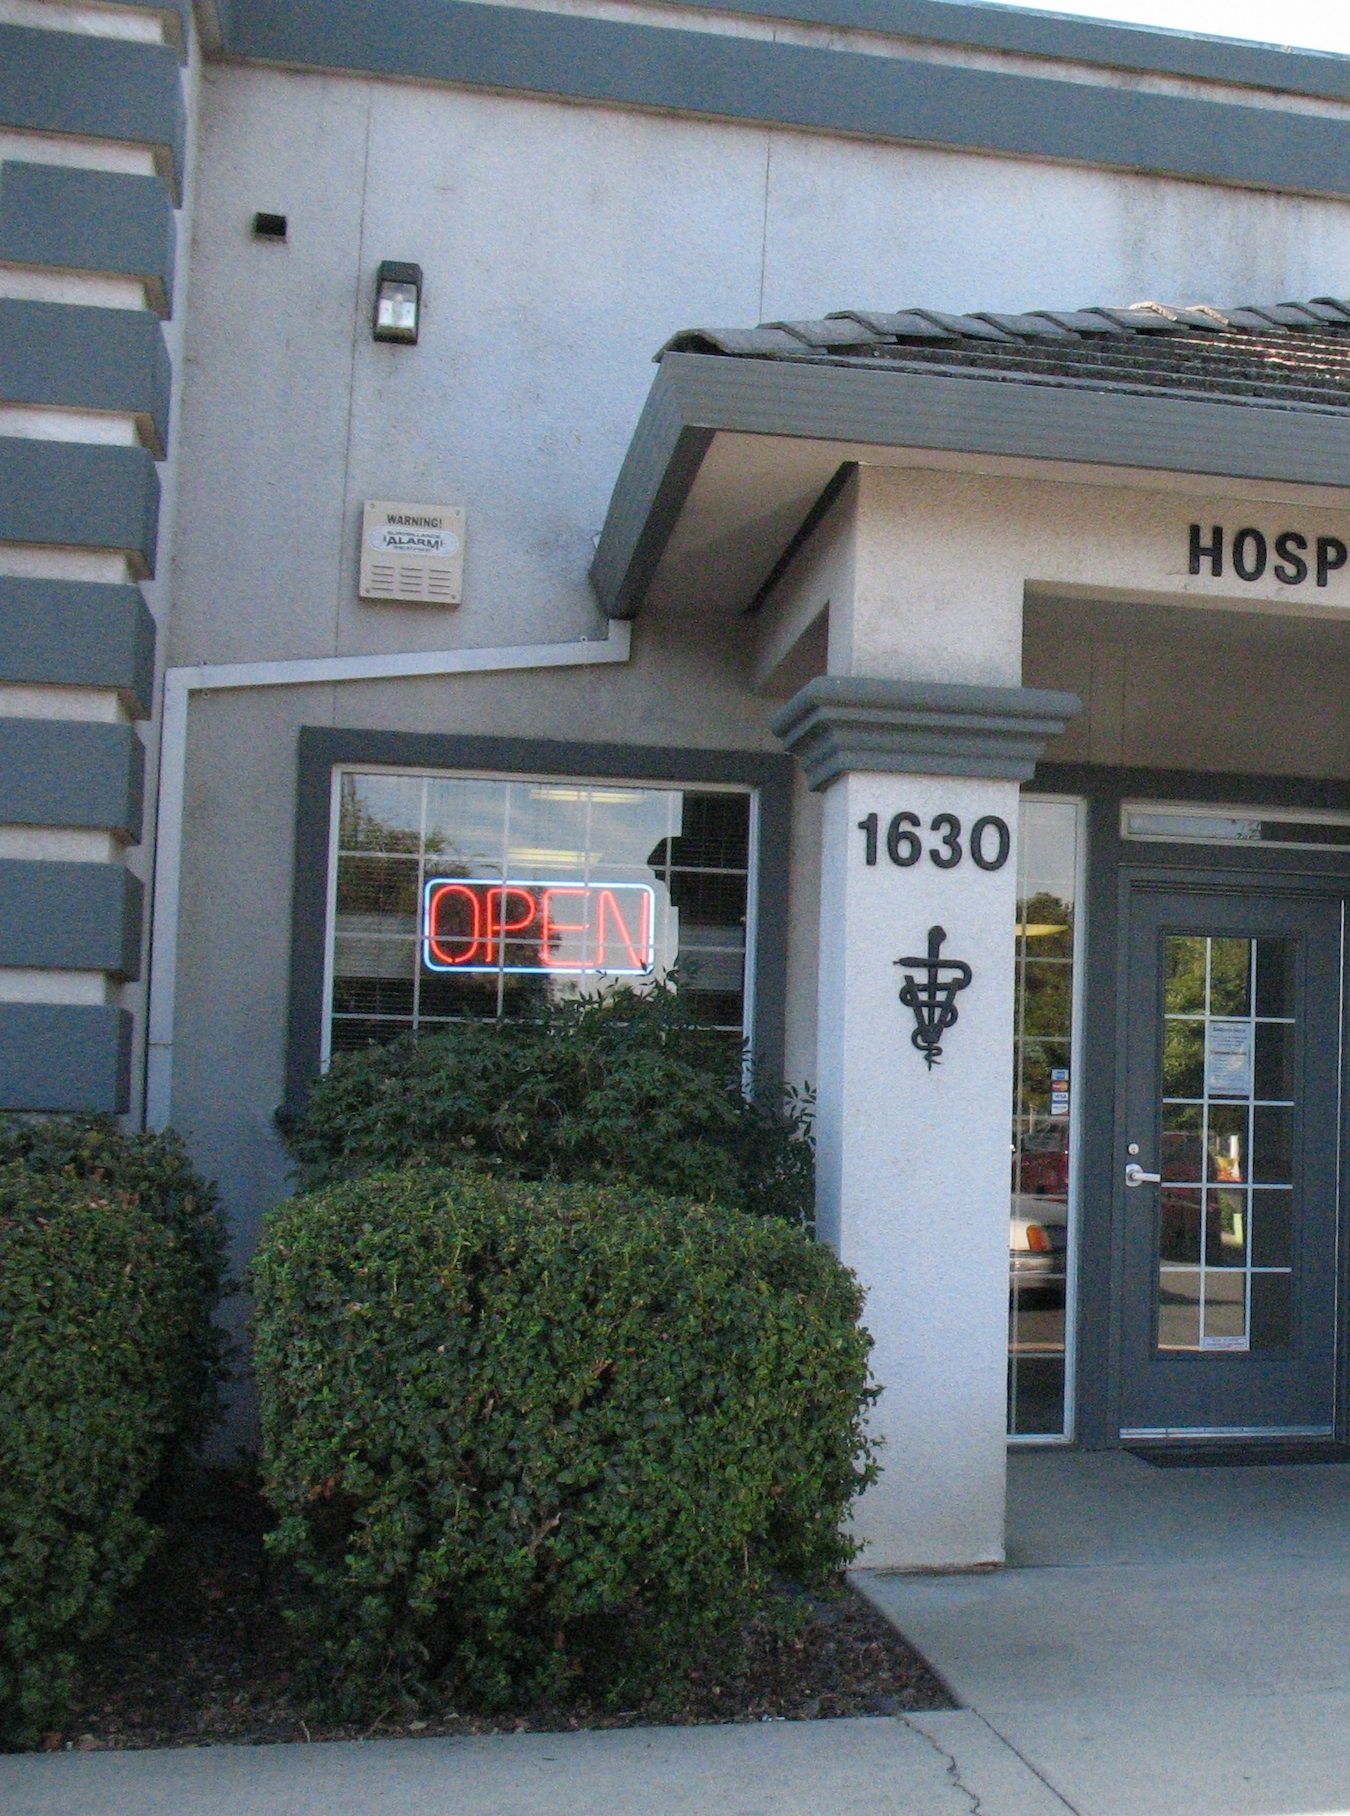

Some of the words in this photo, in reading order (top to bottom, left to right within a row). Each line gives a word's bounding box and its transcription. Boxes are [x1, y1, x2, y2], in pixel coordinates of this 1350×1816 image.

[387, 514, 443, 528] WARNING!
[386, 536, 440, 550] ALARM
[857, 810, 1010, 872] 1630
[429, 885, 649, 967] OPEN
